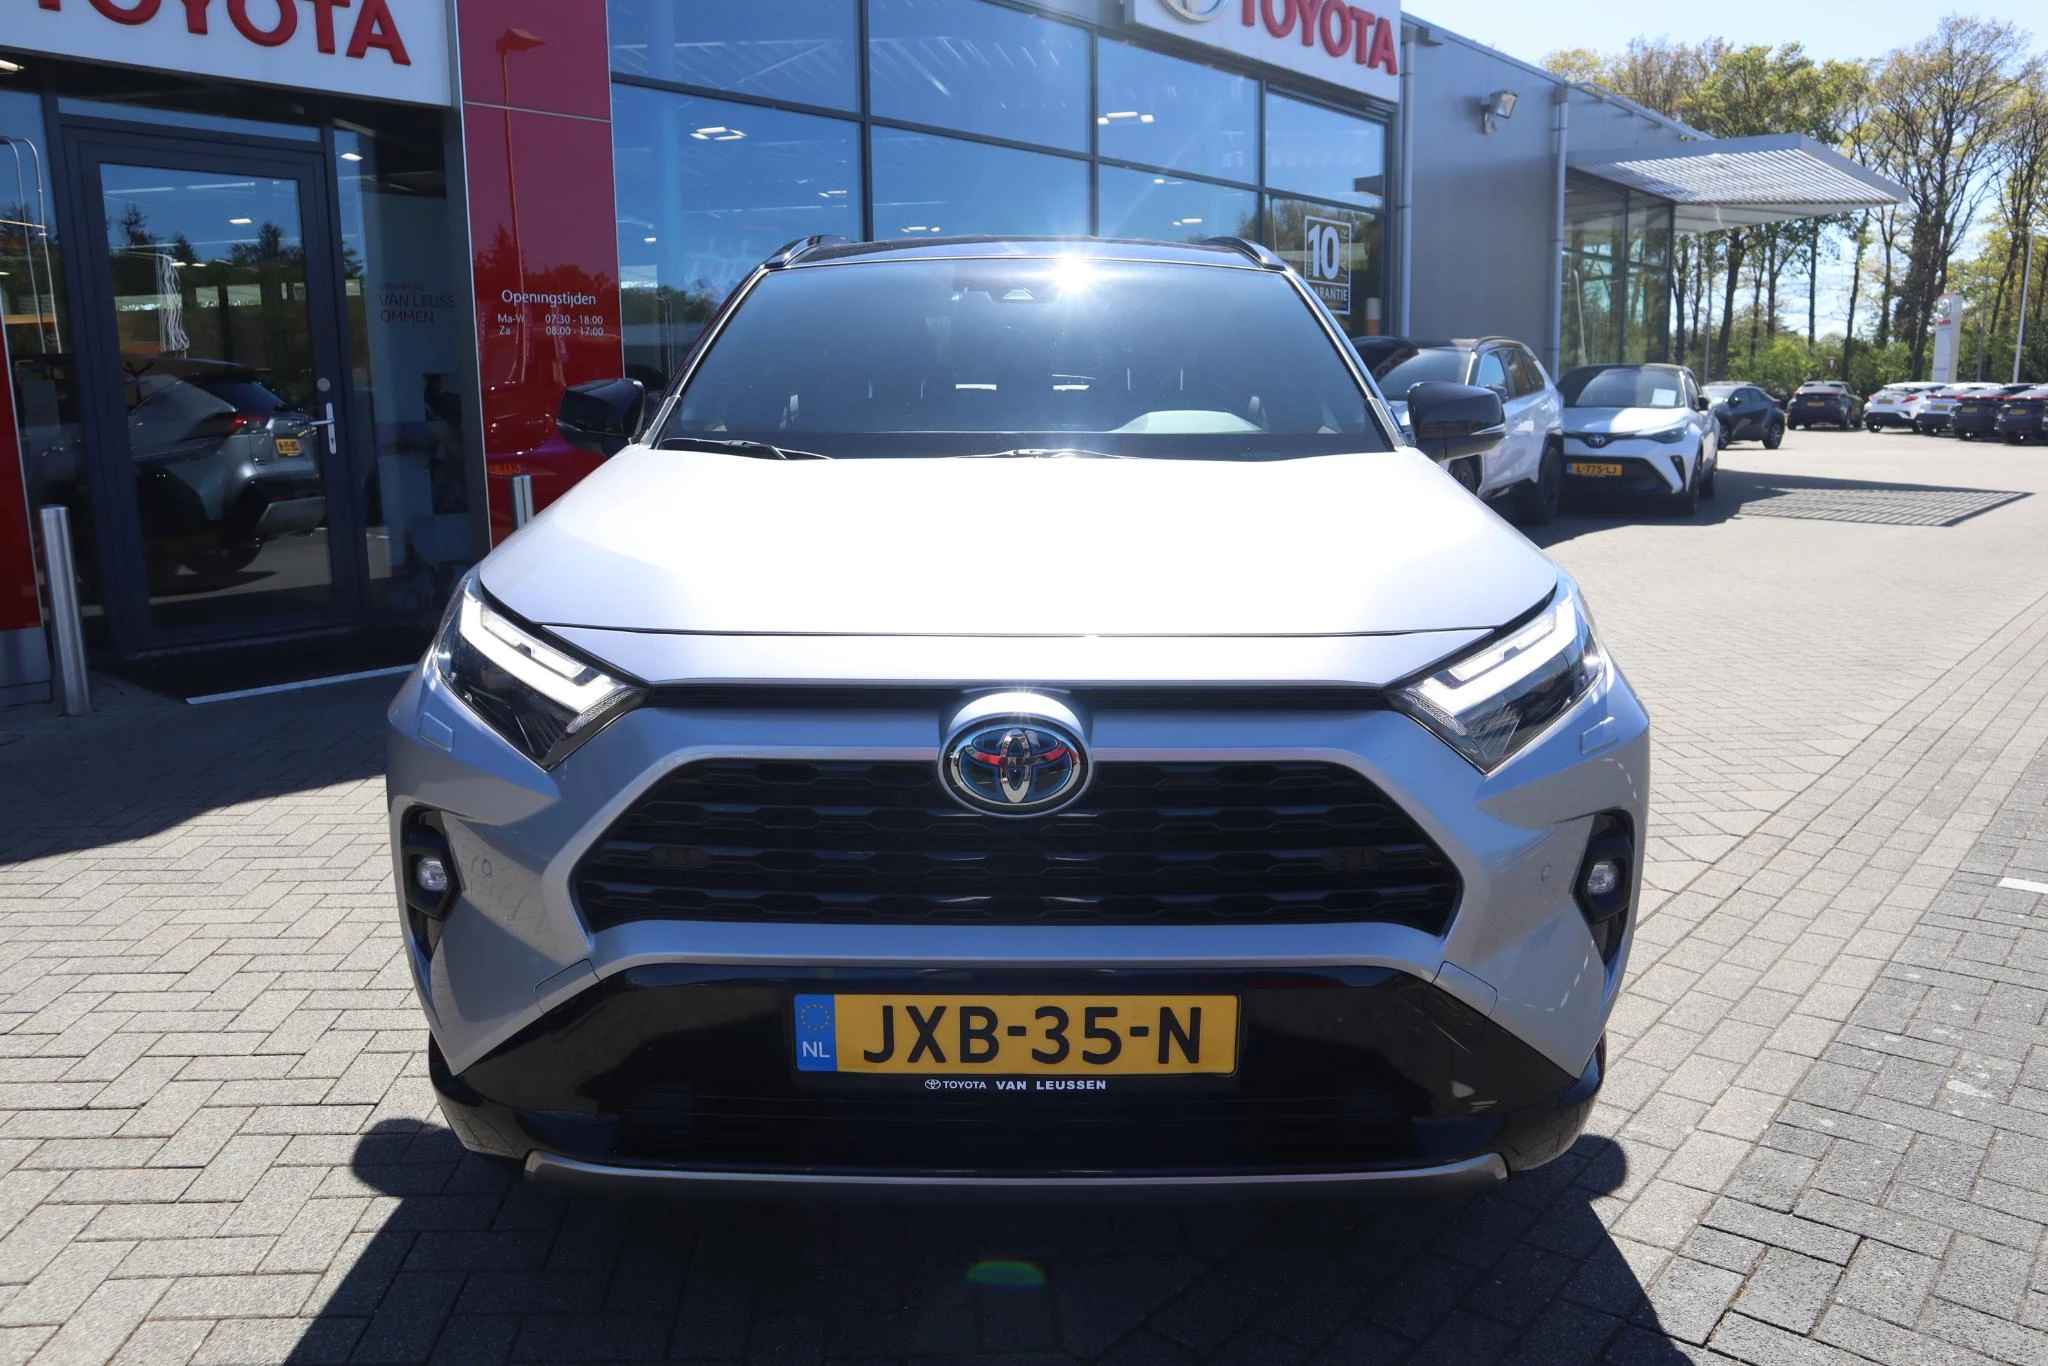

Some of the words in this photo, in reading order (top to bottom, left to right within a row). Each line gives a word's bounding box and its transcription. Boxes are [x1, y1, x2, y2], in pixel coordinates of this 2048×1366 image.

[1308, 224, 1340, 281] 10
[378, 293, 409, 306] VAN
[501, 289, 596, 308] Openingstijden
[1314, 286, 1348, 301] ARANTIE
[380, 310, 435, 323] OMMEN
[545, 314, 571, 324] 07:30
[580, 315, 603, 325] 18:00
[499, 326, 511, 335] Za
[545, 326, 571, 336] 08:00
[580, 326, 604, 336] 17:00
[864, 1005, 1202, 1065] JXB-35-N
[802, 1041, 831, 1058] NL
[943, 1080, 987, 1089] TOYOTA
[996, 1080, 1027, 1090] VAN
[1036, 1080, 1107, 1090] LEUSSEN
